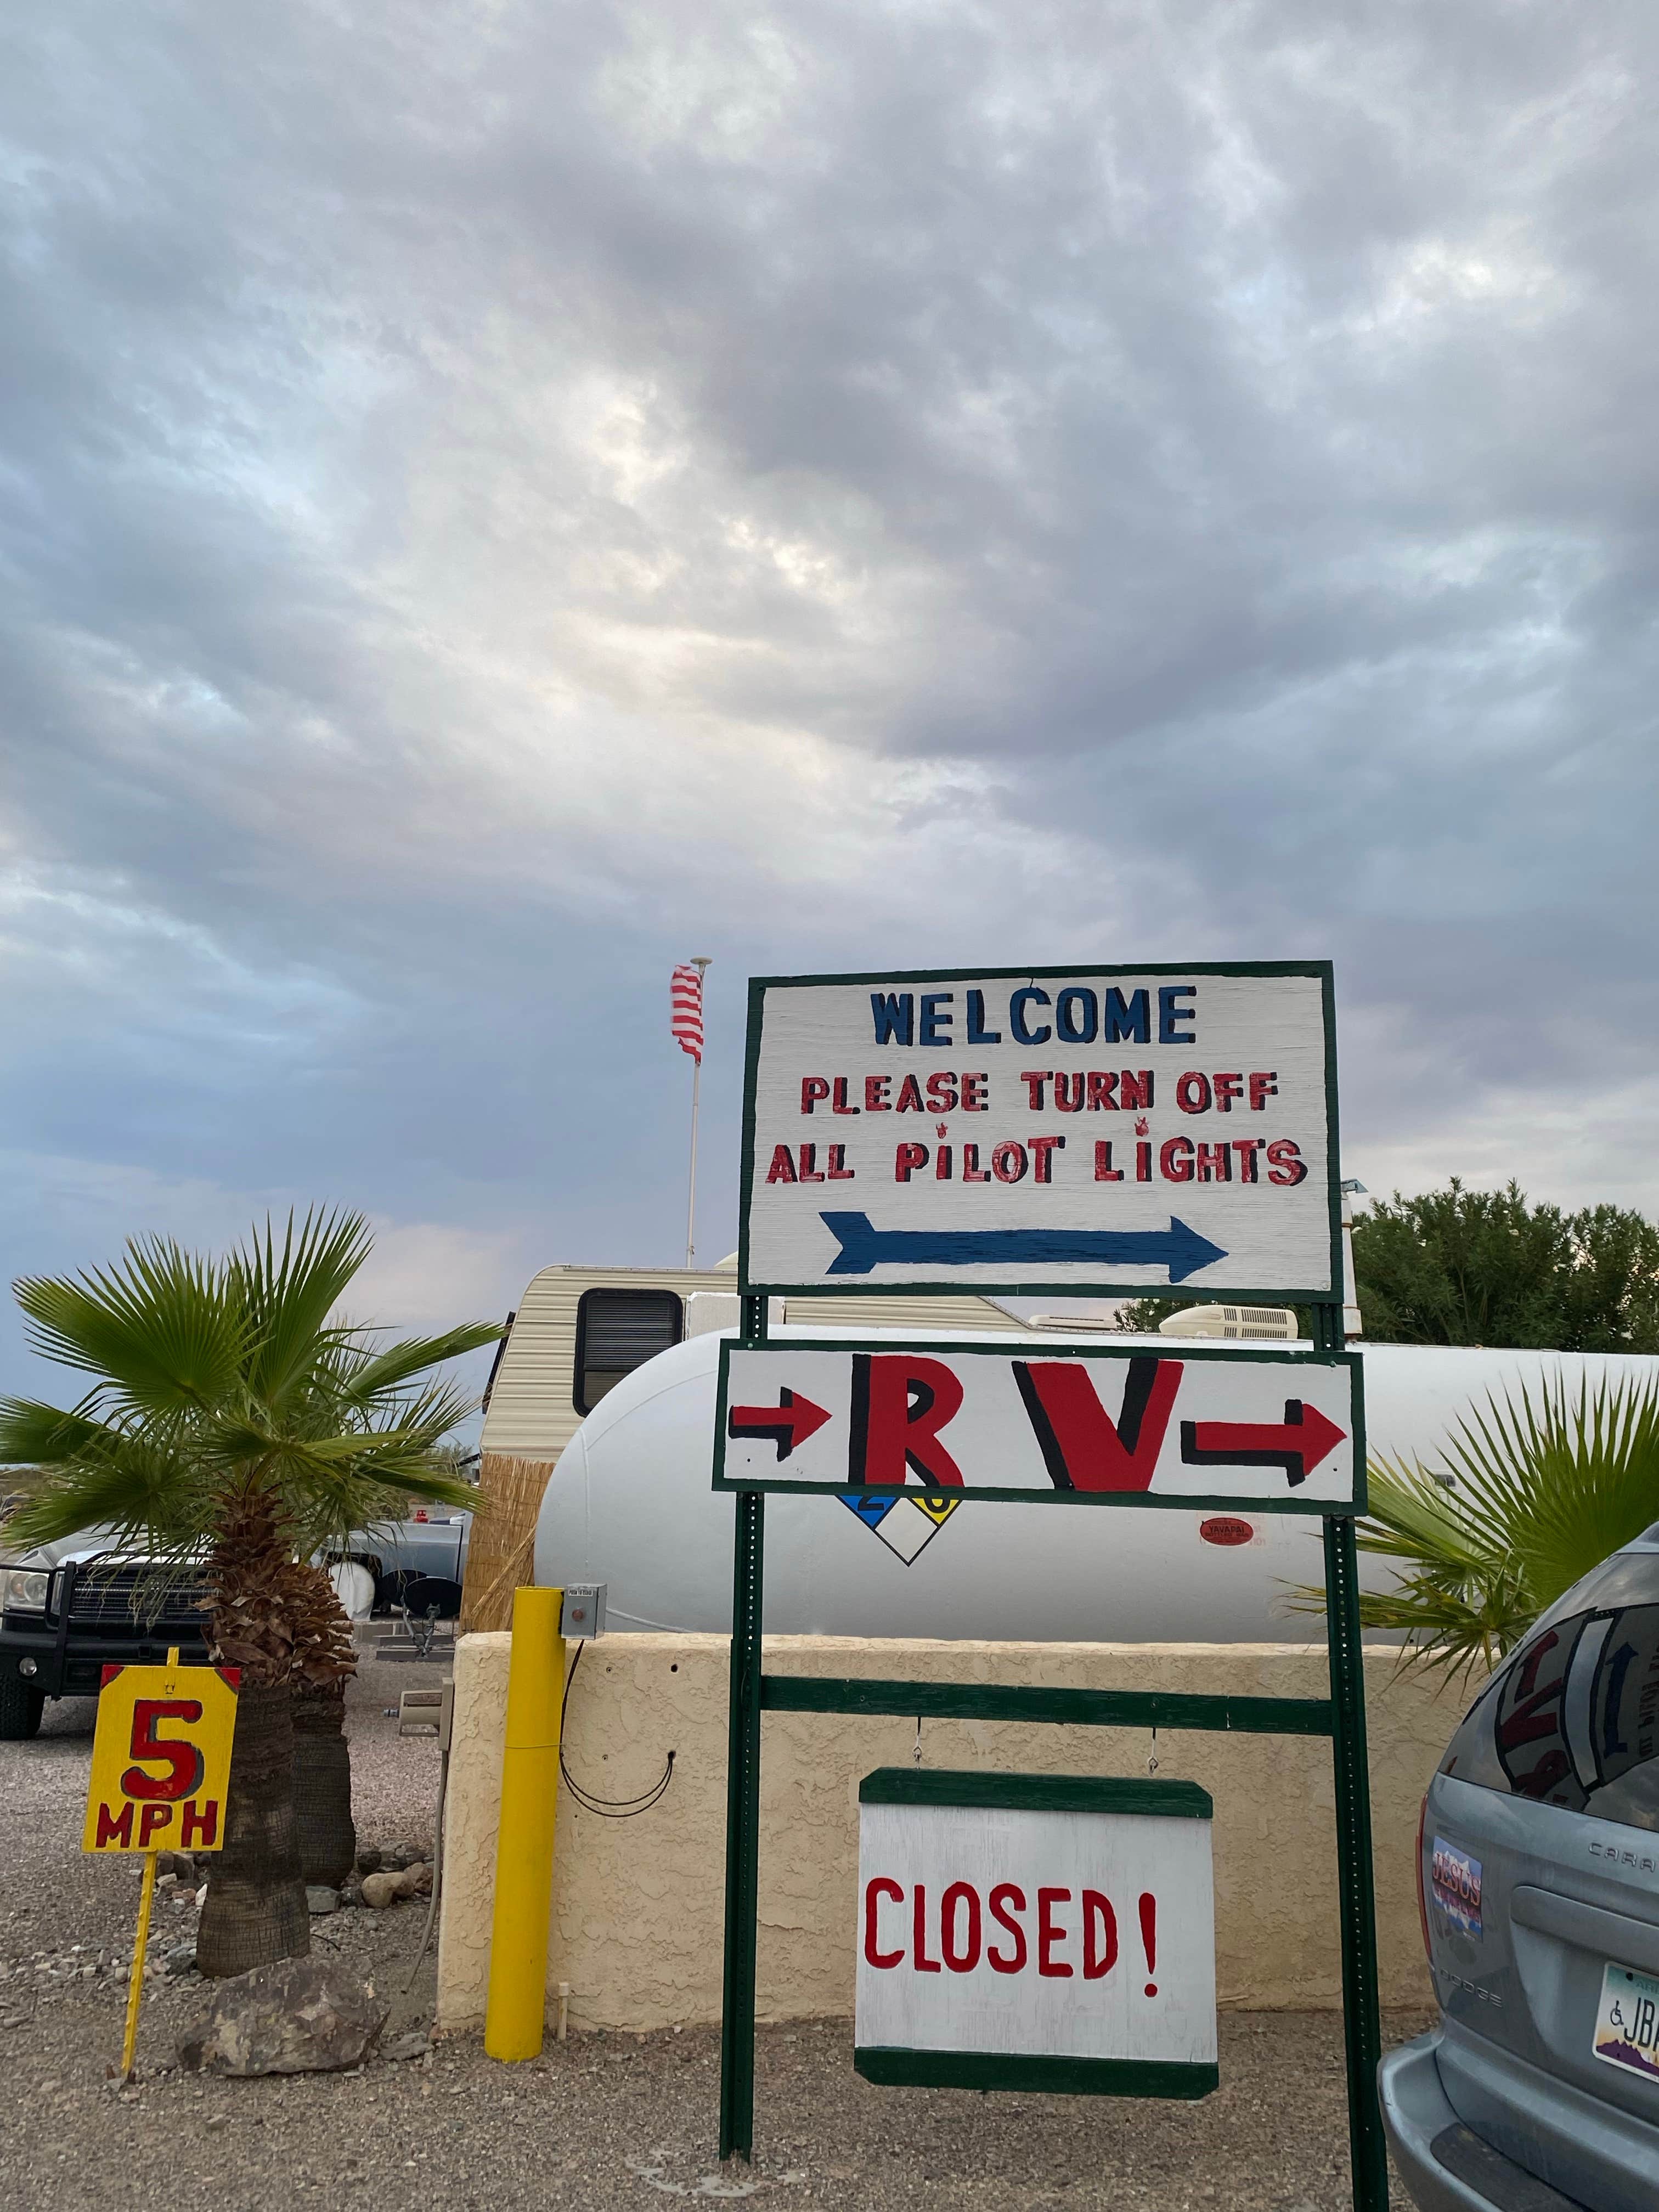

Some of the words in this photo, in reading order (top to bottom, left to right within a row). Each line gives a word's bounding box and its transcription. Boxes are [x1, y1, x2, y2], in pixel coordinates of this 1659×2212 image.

[871, 985, 1197, 1046] WELCOME
[802, 1072, 989, 1114] PLEASE
[1021, 1070, 1154, 1112] TURN
[1177, 1072, 1278, 1114] OFF
[767, 1143, 854, 1184] ALL
[121, 1699, 205, 1802] 5
[95, 1800, 218, 1848] MPH
[1432, 1851, 1481, 1906] JESUS
[1588, 1842, 1656, 1872] CARA
[1440, 1968, 1504, 2008] DODGE
